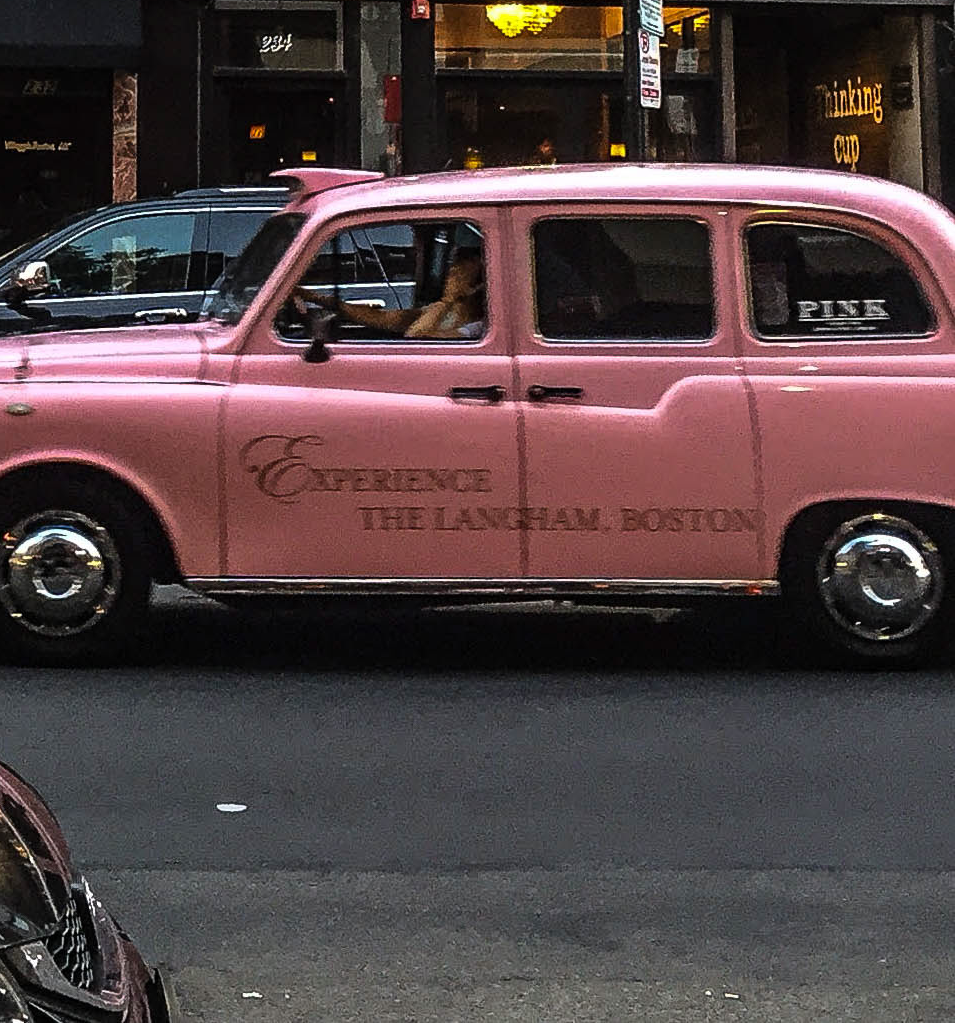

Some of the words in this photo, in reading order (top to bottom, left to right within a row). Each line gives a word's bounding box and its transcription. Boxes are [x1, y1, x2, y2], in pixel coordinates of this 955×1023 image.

[259, 33, 293, 53] 234
[833, 134, 860, 173] cup
[796, 299, 891, 318] PINK
[358, 506, 426, 530] THE
[621, 507, 765, 533] BOSTON
